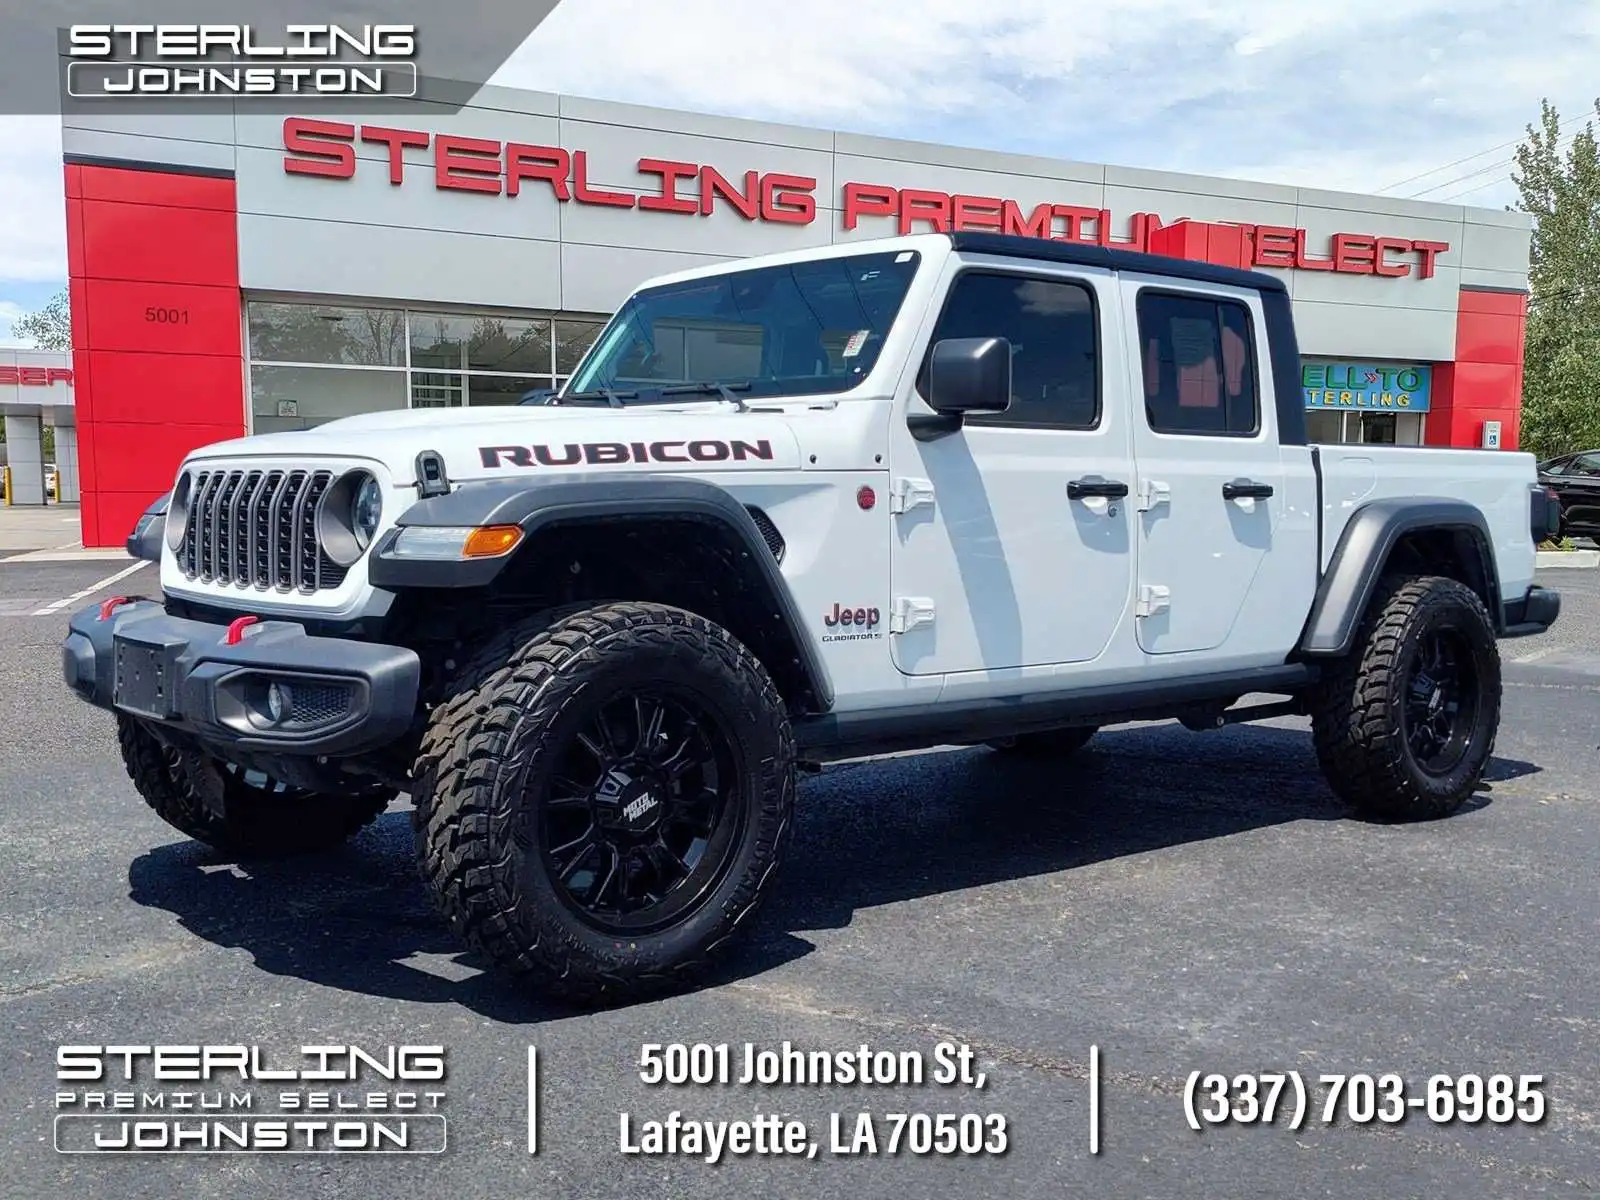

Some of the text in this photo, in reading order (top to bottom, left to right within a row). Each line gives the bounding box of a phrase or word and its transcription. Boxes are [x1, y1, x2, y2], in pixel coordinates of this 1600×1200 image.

[283, 117, 817, 226] STERLING
[1218, 221, 1450, 281] ELECT
[144, 306, 190, 326] 5001
[1376, 366, 1424, 393] TO
[478, 440, 774, 469] RUBICON
[824, 602, 881, 630] Jeep
[822, 633, 873, 643] GLADIATOR
[623, 791, 649, 817] MOTO
[628, 796, 658, 822] METAL
